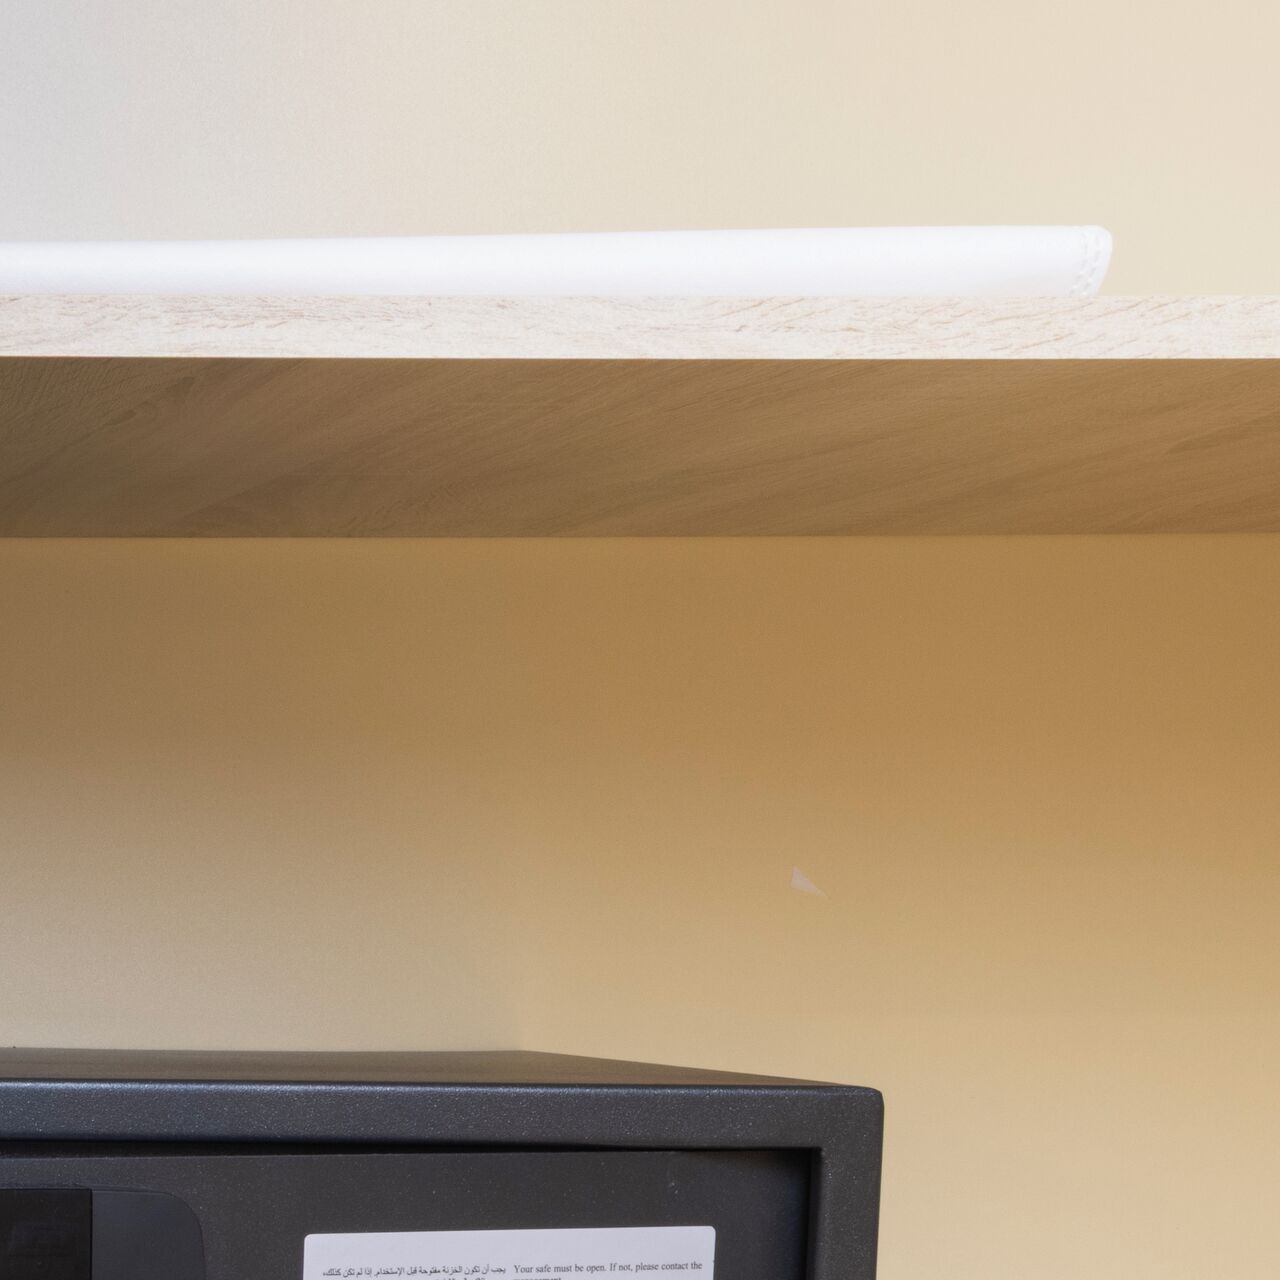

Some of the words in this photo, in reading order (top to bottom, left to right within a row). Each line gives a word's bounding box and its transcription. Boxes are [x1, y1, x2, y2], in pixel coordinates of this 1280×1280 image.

[514, 1264, 533, 1273] Your
[535, 1264, 551, 1272] safe
[586, 1265, 606, 1273] open.
[610, 1262, 617, 1271] If
[635, 1262, 659, 1272] please
[661, 1262, 688, 1270] contact
[690, 1260, 702, 1269] the
